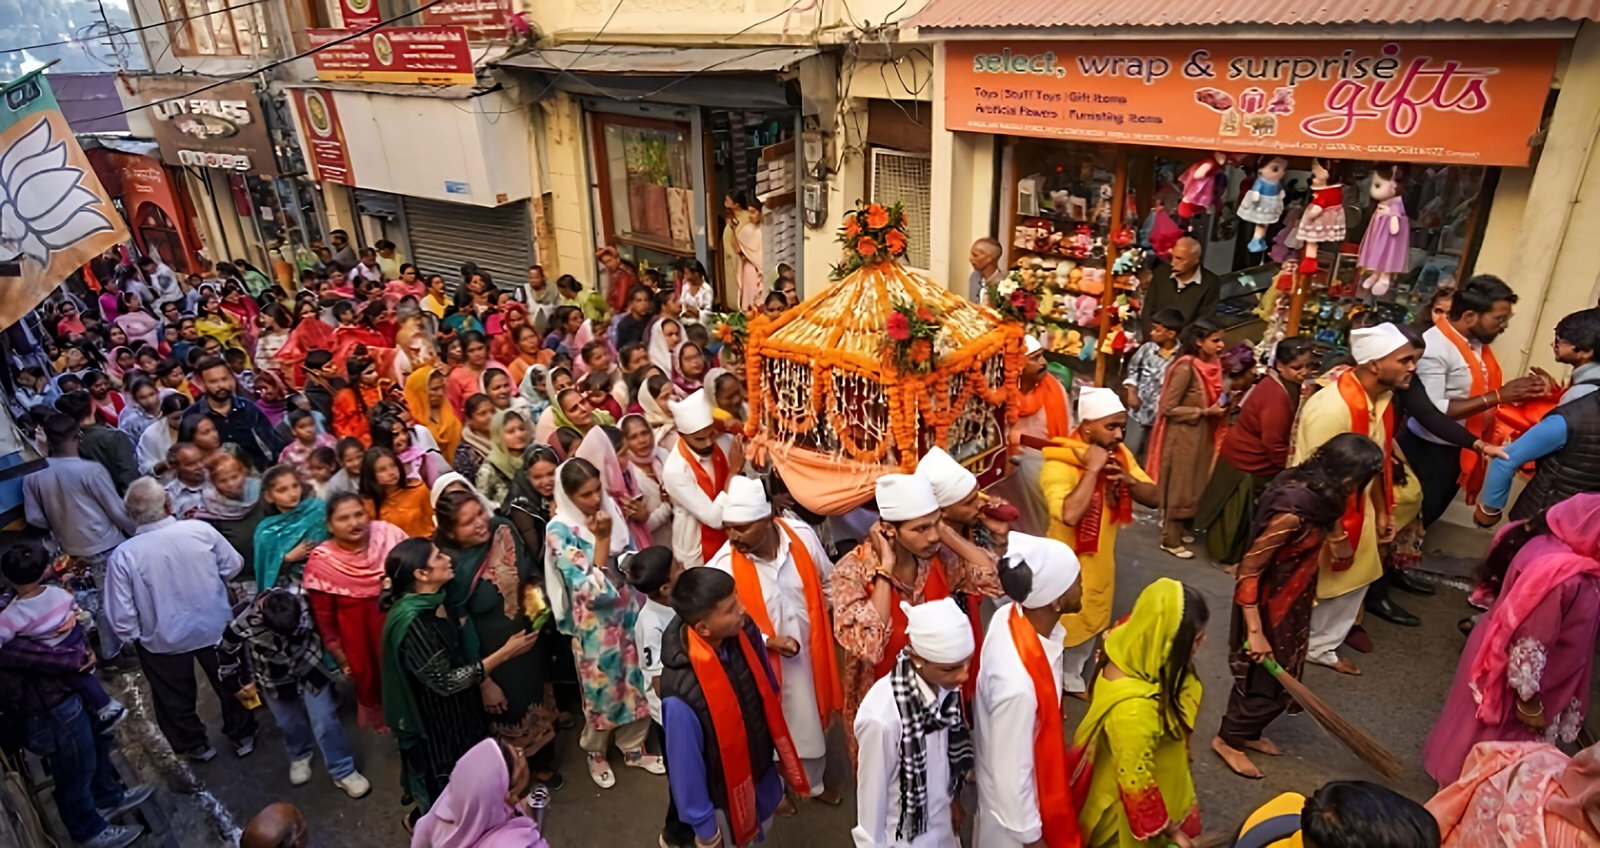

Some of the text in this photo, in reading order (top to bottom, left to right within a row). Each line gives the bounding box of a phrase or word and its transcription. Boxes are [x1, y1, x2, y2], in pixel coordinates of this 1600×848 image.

[973, 48, 1399, 88] select, wrap & surprise
[1300, 43, 1499, 139] gifts
[643, 646, 653, 667] 3
